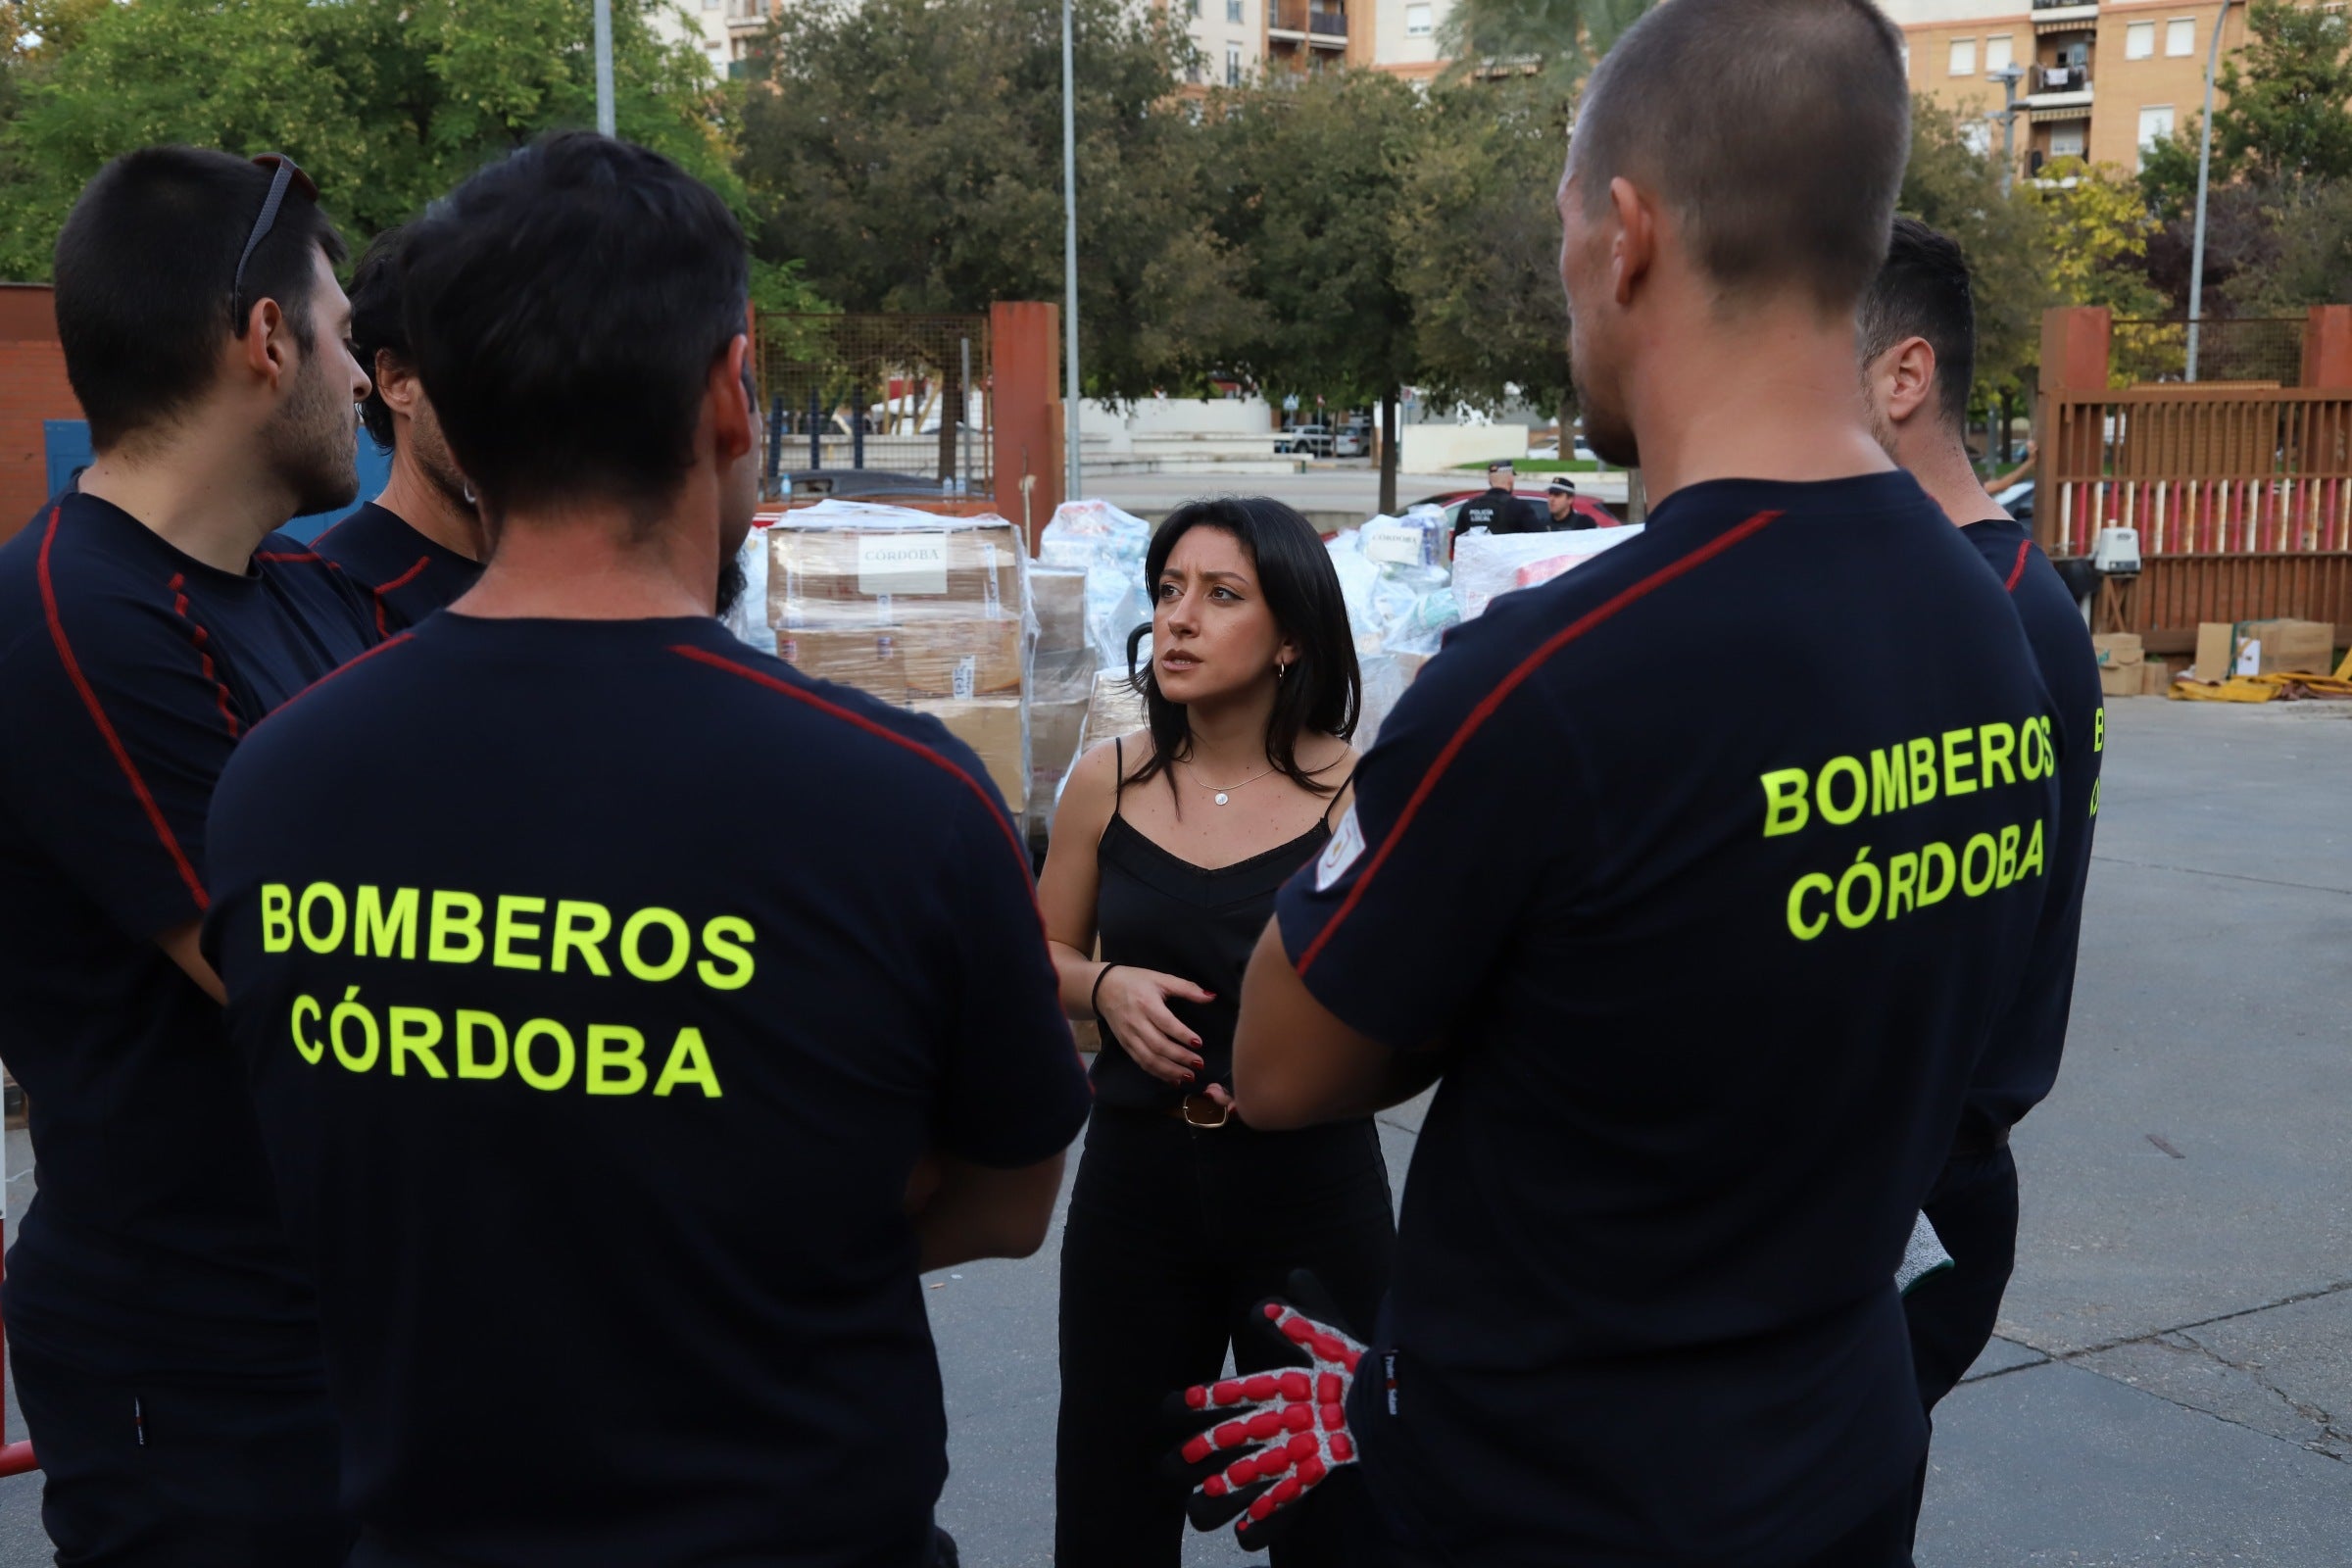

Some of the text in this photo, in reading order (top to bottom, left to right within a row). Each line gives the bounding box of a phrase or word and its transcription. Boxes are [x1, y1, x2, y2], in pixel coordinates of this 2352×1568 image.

[1761, 714, 2055, 837] BOMBEROS
[262, 881, 756, 990] BOMBEROS
[1787, 819, 2044, 941] CÓRDOBA
[291, 985, 722, 1098] CÓRDOBA
